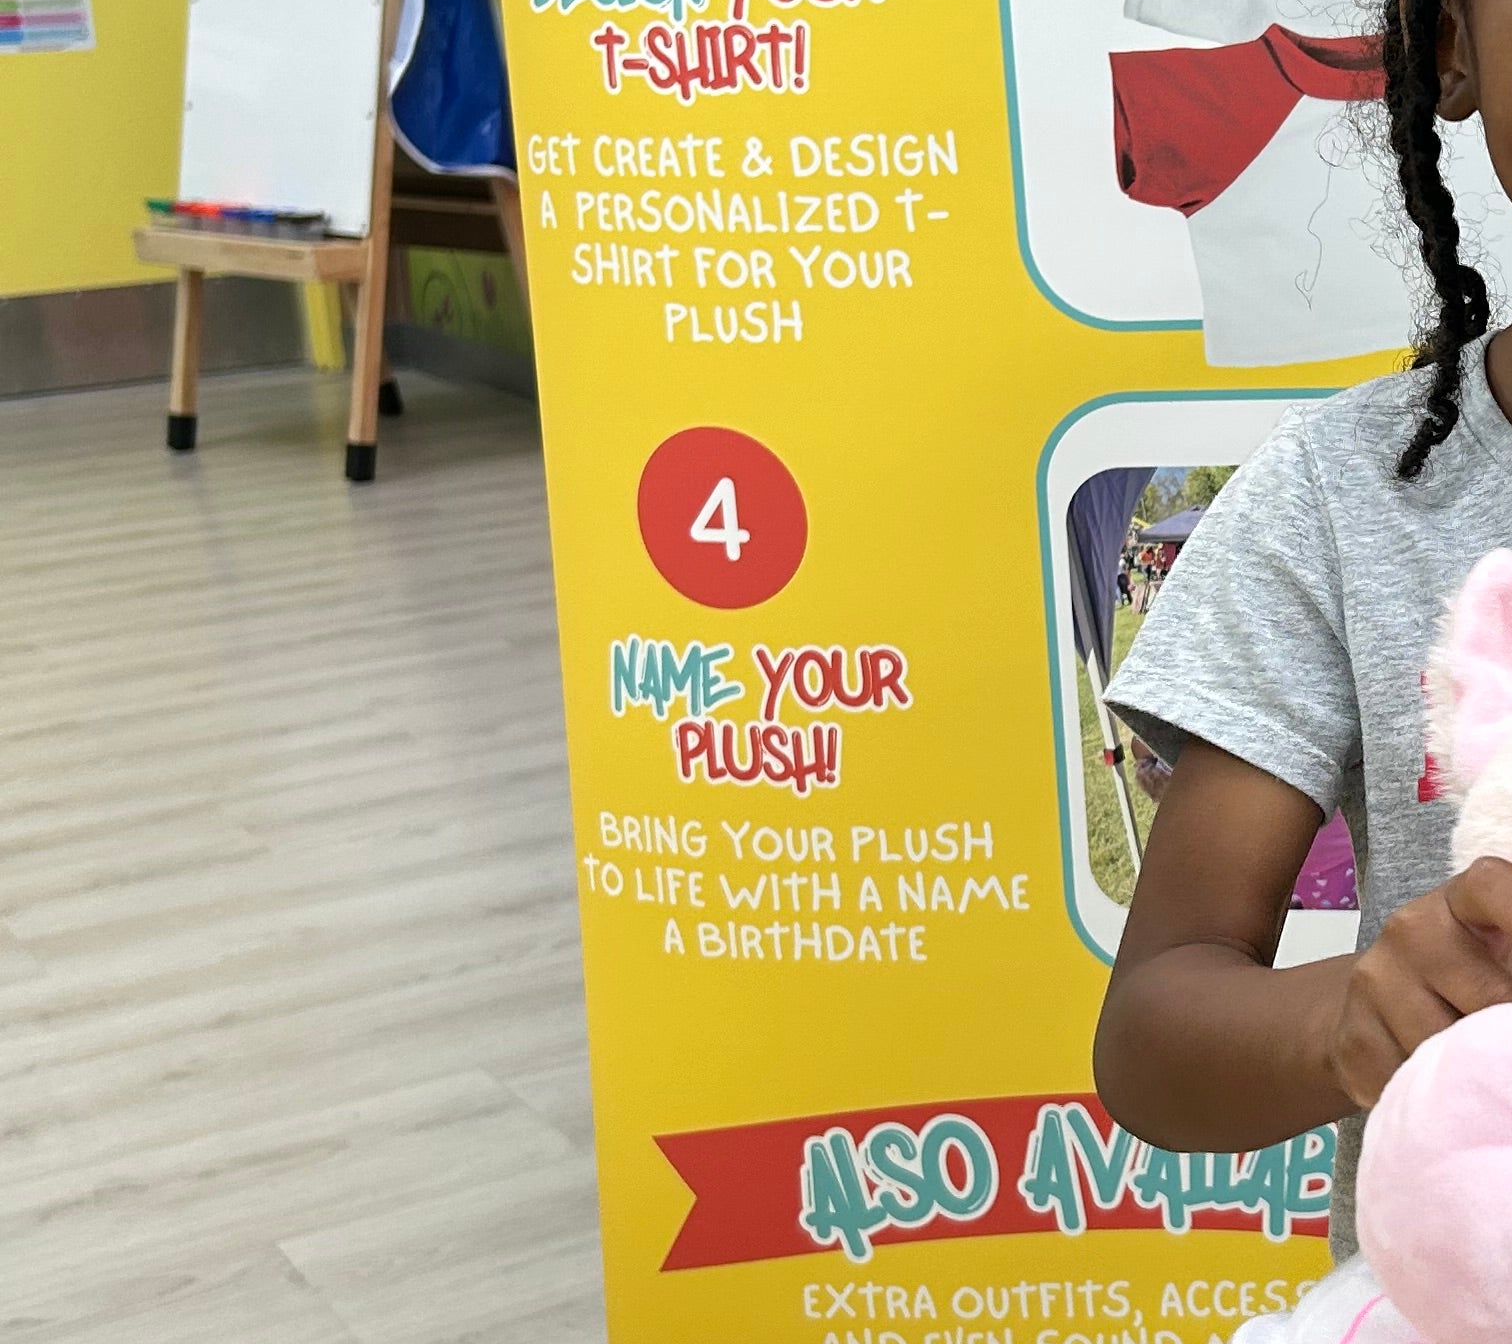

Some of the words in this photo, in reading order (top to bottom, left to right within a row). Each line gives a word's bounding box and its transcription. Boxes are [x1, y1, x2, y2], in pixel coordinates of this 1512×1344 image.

[594, 25, 806, 101] T-SHIRT!
[528, 133, 581, 176] GET
[593, 133, 725, 178] CREATE
[741, 136, 774, 178] &
[790, 130, 959, 177] DESIGN
[540, 190, 558, 230] A
[575, 188, 880, 234] PERSONALIZED
[894, 188, 950, 233] T-
[571, 242, 680, 289] SHIRT
[694, 246, 777, 289] FOR
[788, 244, 914, 289] YOUR
[664, 299, 804, 344] PLUSH
[690, 476, 751, 563] 4
[612, 637, 742, 717] NAME
[756, 648, 909, 721] YOUR
[676, 721, 839, 793] PLUSH!
[599, 810, 708, 856] BRING
[721, 820, 833, 862] YOUR
[851, 821, 994, 862] PLUSH
[583, 853, 624, 897] TO
[635, 865, 706, 905] LIFE
[719, 871, 842, 912] WITH
[858, 875, 884, 912] A
[897, 871, 1031, 913] NAME
[663, 919, 685, 955] A
[698, 920, 928, 961] BIRTHDATE
[804, 1115, 993, 1261] ALSO
[1022, 1106, 1335, 1239] AVAILAB
[803, 1281, 937, 1320] EXTRA
[950, 1279, 1145, 1328] OUTFITS,
[1160, 1279, 1320, 1318] ACCES
